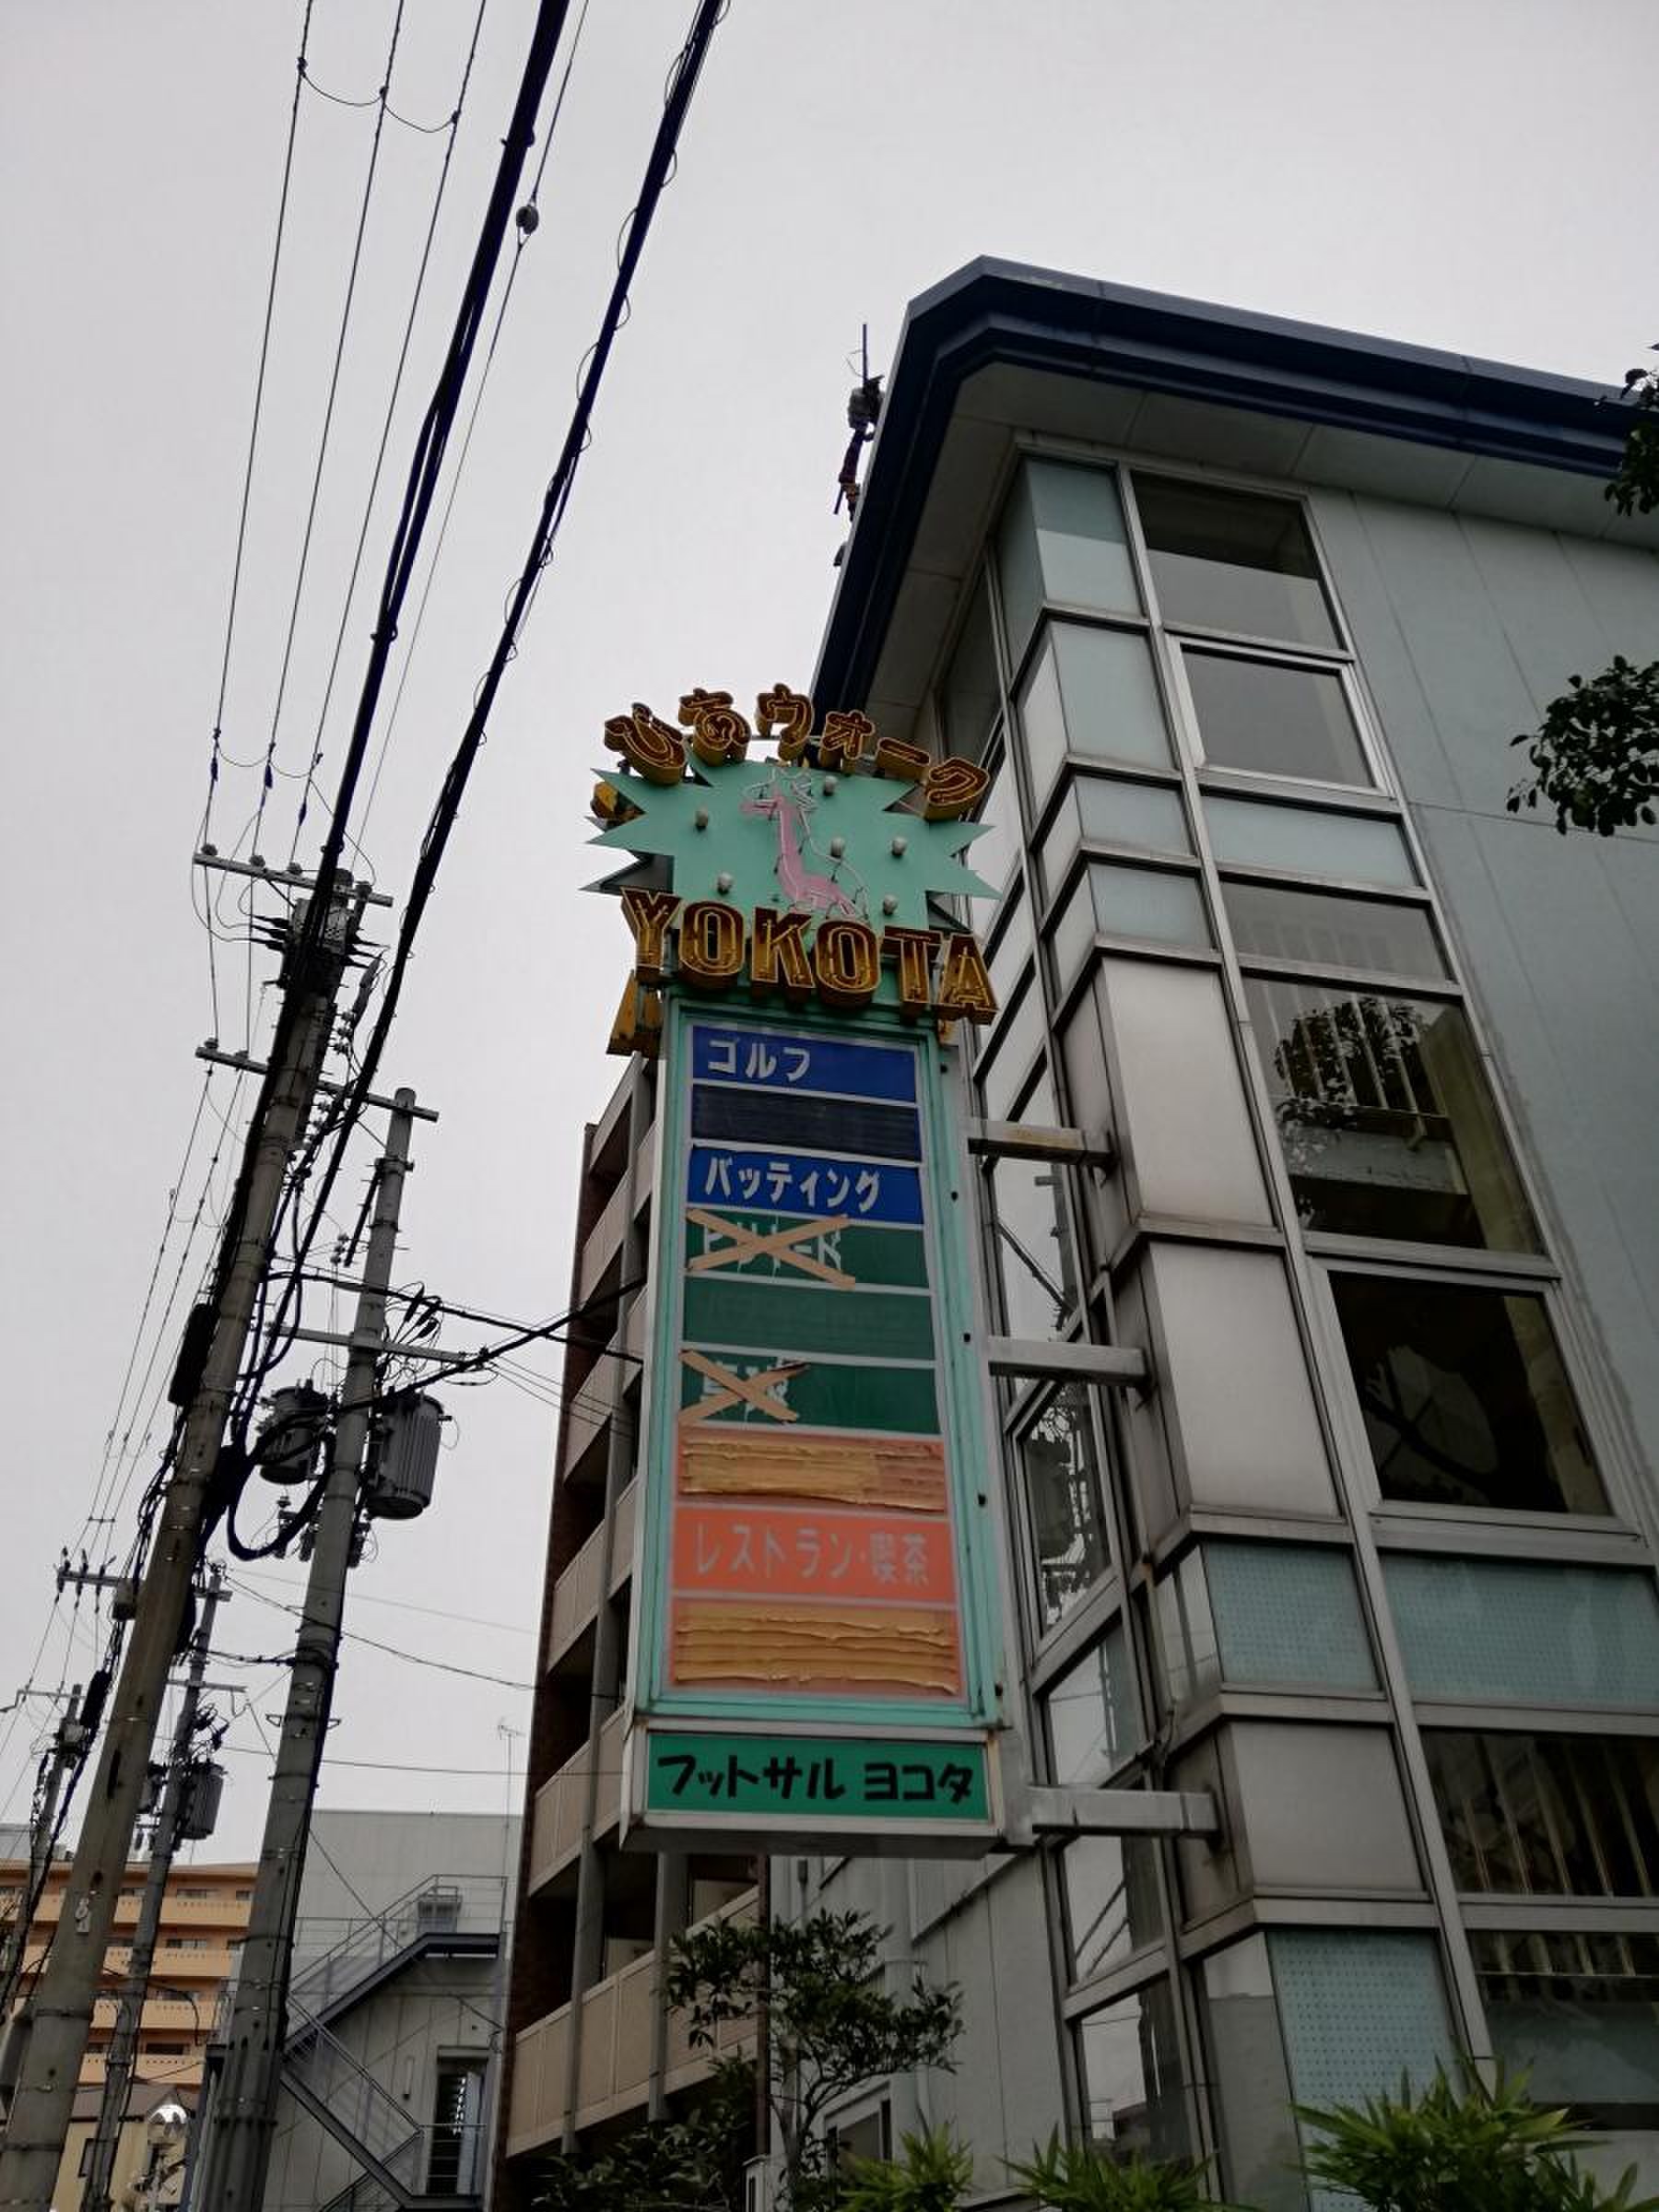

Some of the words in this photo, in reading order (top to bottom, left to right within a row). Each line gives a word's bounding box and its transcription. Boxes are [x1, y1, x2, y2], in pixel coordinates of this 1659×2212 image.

[620, 887, 999, 1023] YOKOTA
[707, 1037, 811, 1082] ゴルフ
[705, 1157, 880, 1213] バッティング
[695, 1523, 931, 1586] レストラン・喫茶
[657, 1754, 845, 1799] フットサル
[864, 1762, 973, 1804] ヨコタ
